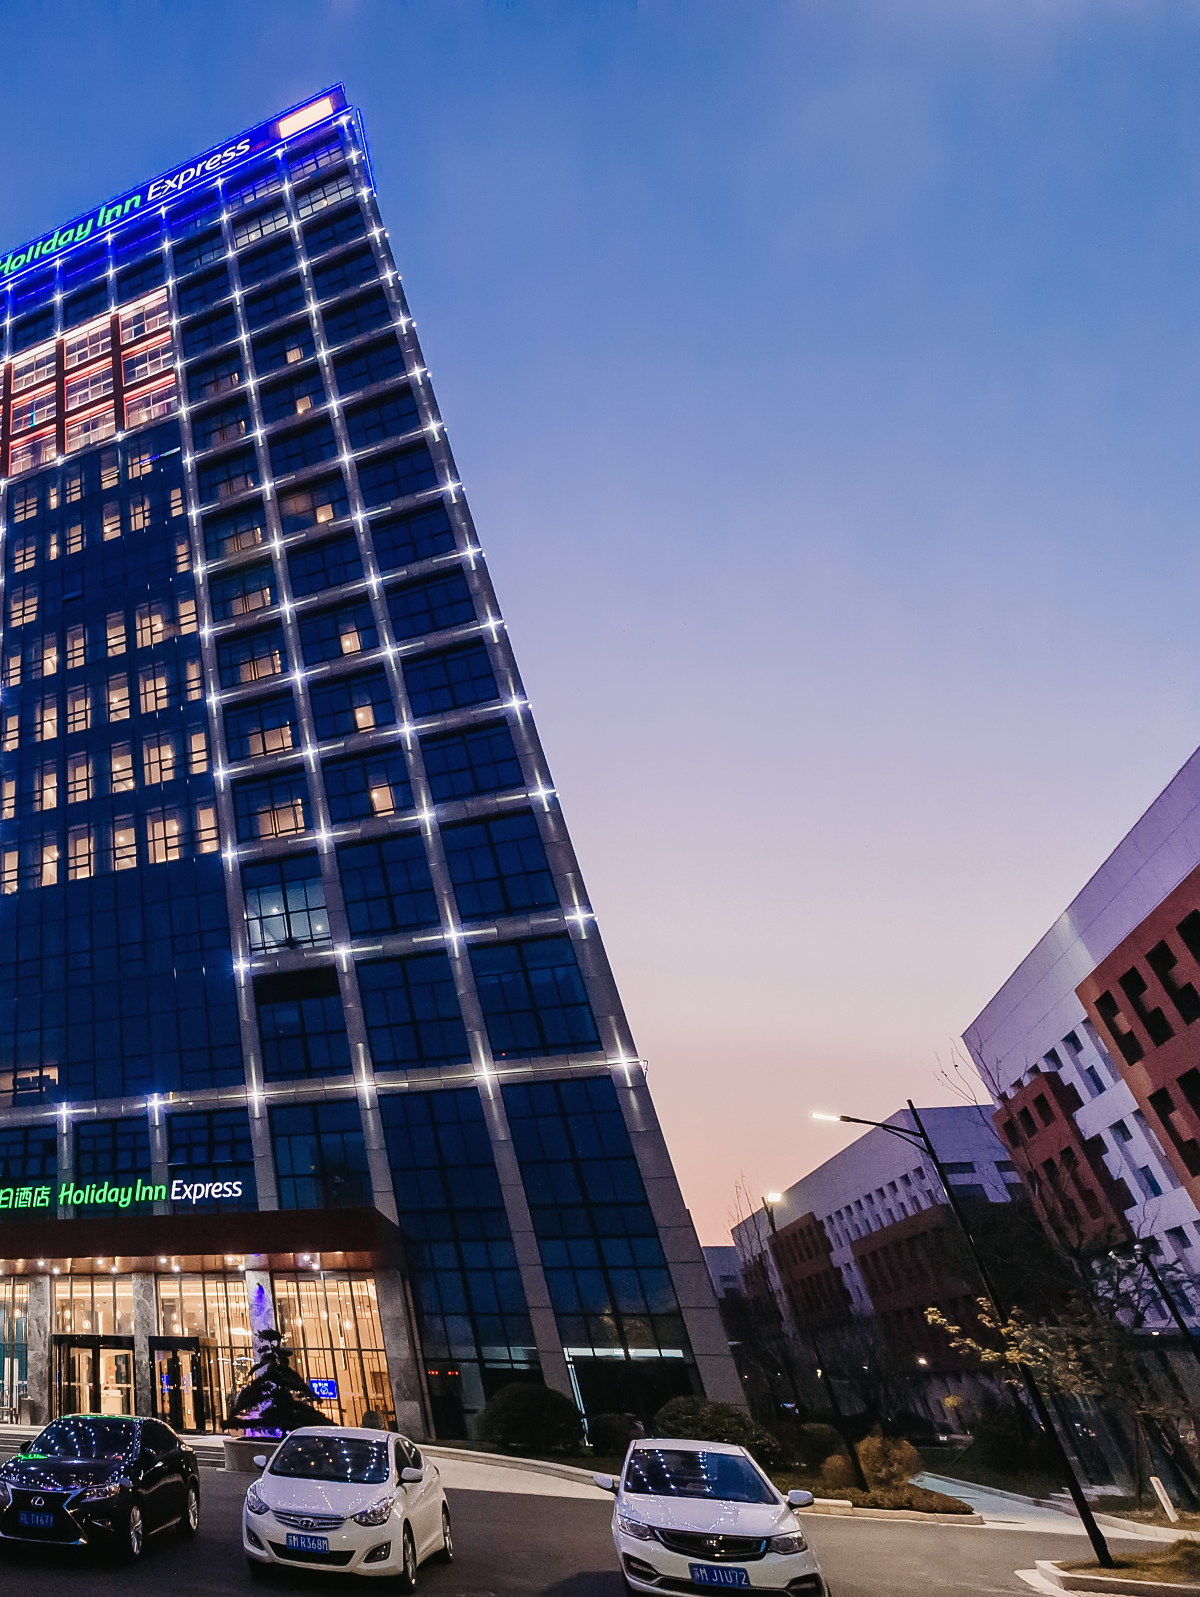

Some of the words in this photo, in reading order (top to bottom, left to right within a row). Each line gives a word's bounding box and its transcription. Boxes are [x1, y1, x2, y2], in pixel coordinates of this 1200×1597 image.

[96, 194, 141, 227] Inn
[147, 139, 250, 201] Express
[58, 1181, 132, 1208] Holiday
[135, 1179, 167, 1202] Inn
[171, 1179, 243, 1205] Express
